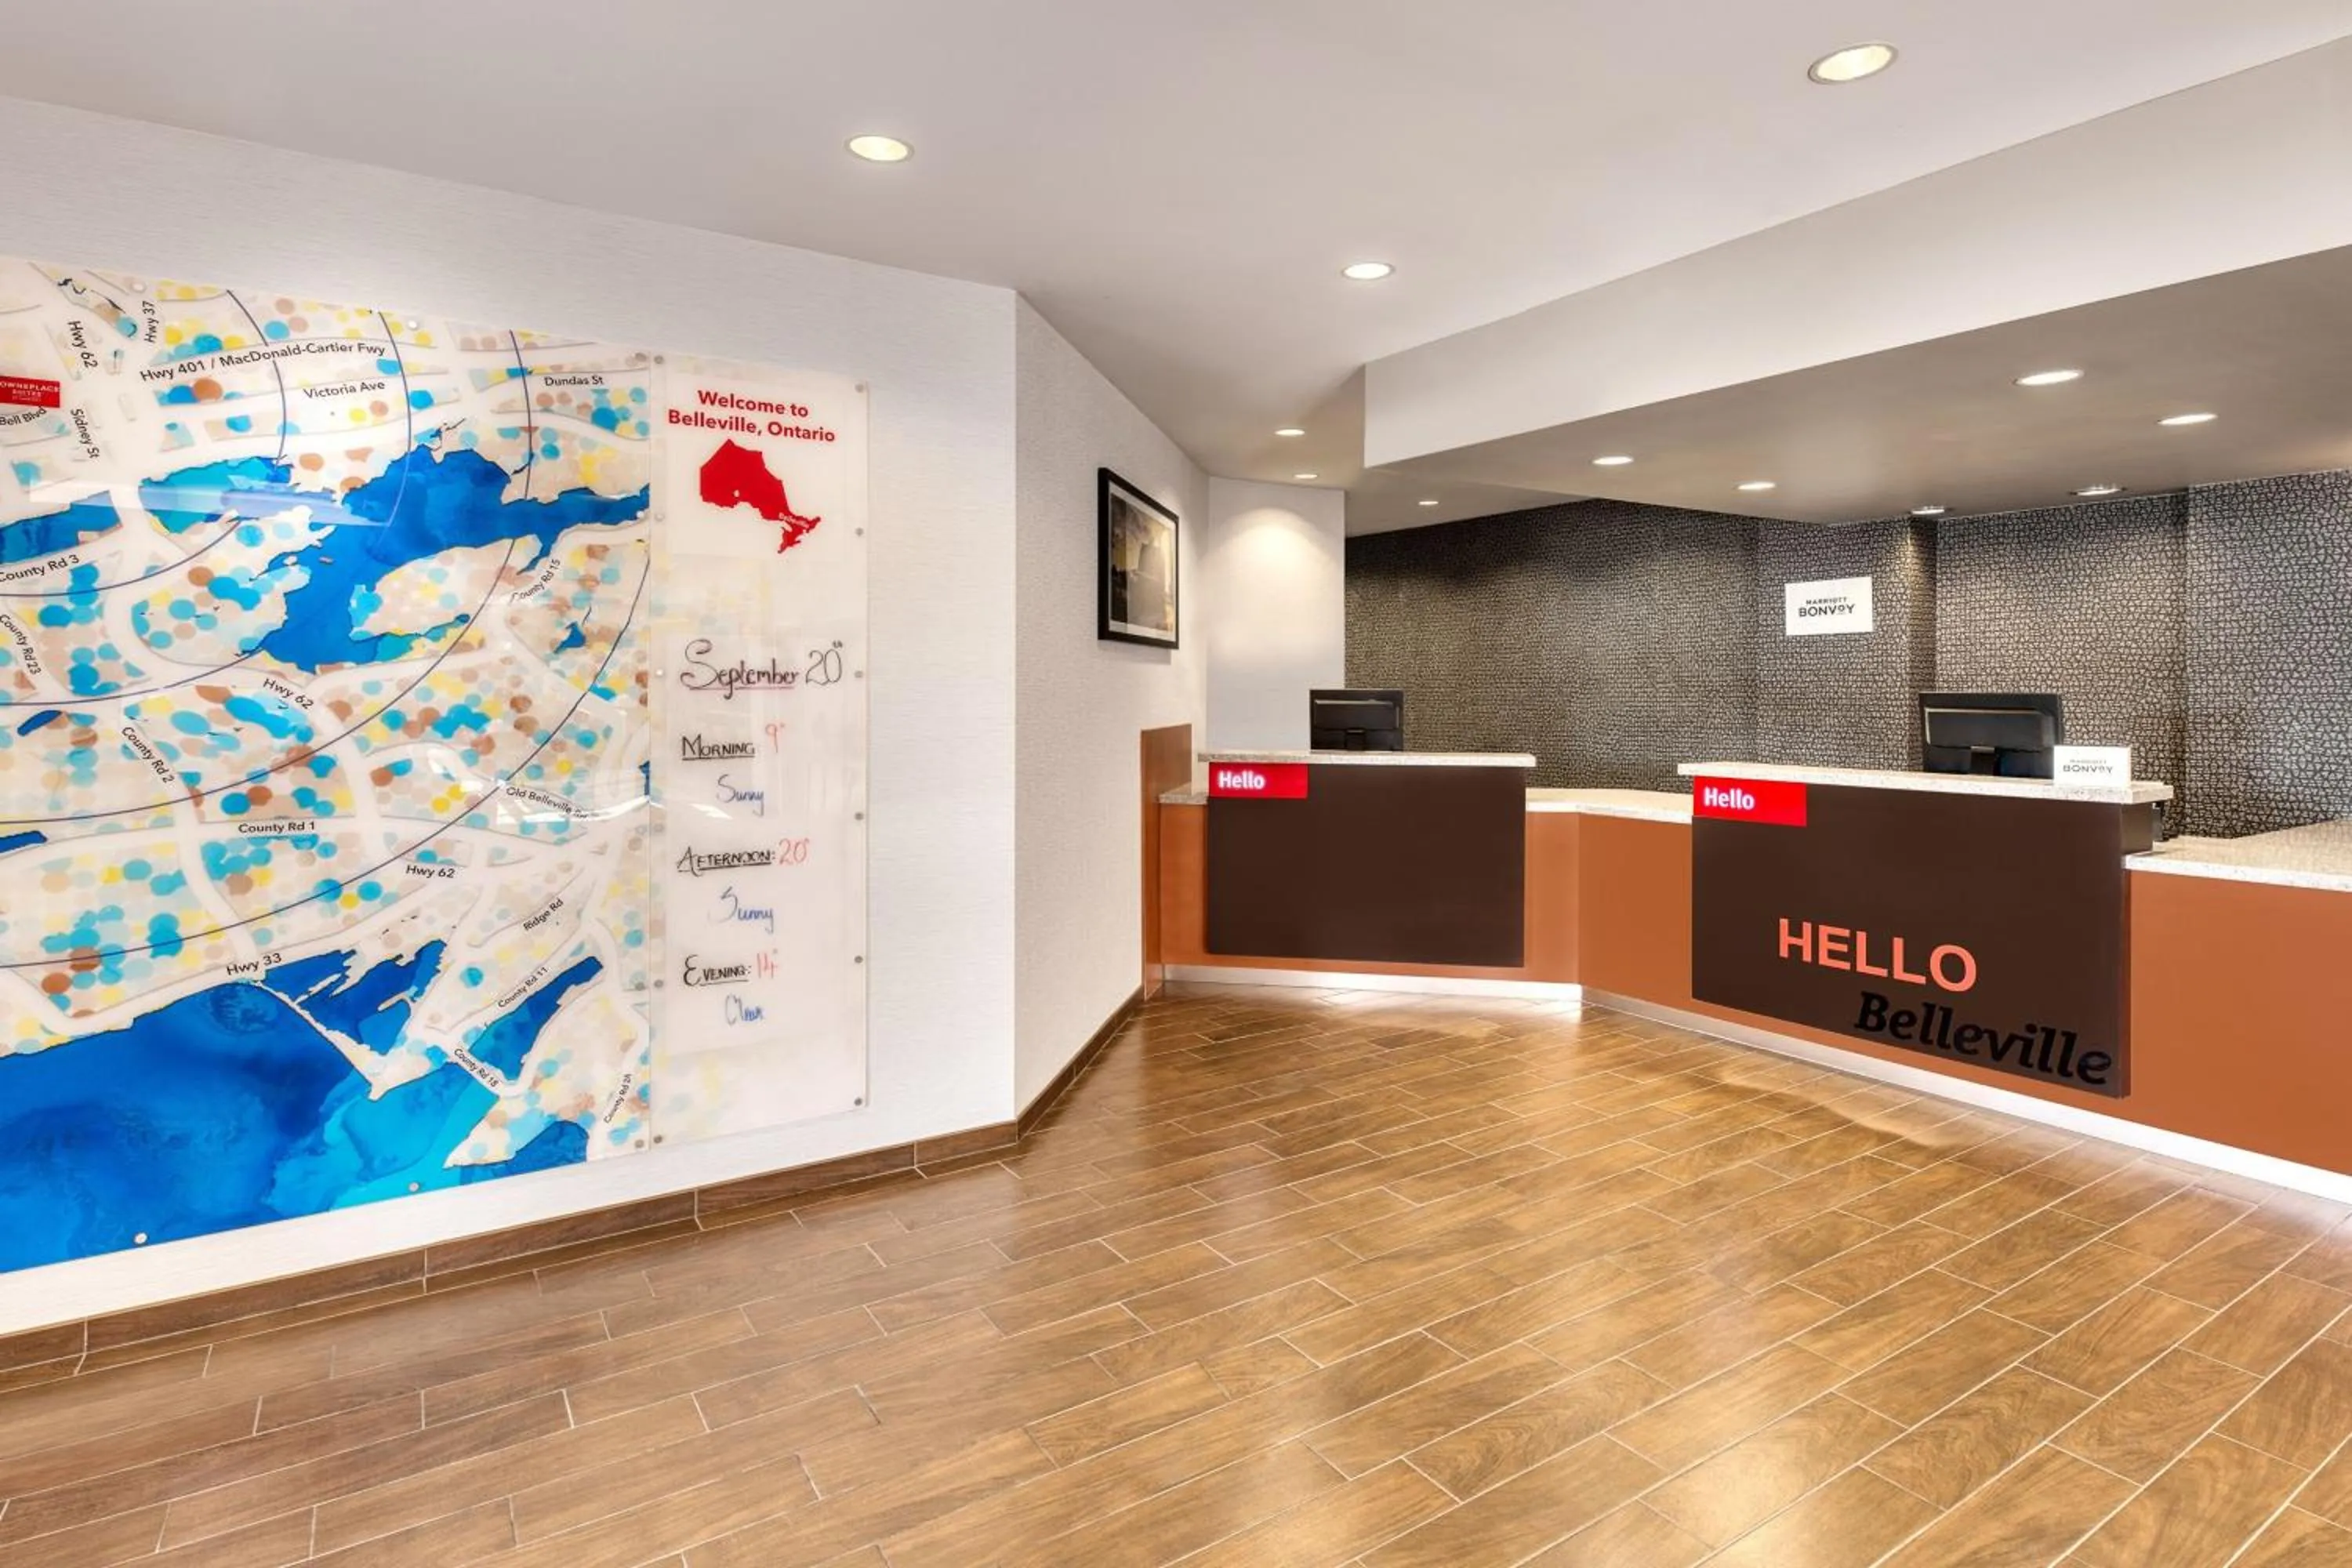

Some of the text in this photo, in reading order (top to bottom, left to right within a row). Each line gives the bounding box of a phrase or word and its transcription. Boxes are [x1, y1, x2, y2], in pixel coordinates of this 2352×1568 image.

[142, 301, 158, 343] Hwy 37
[67, 320, 98, 368] Hwy 62
[140, 368, 174, 382] Hwy
[177, 359, 206, 375] 401
[220, 342, 352, 367] MacDonald-Cartier
[358, 343, 385, 357] Fwy
[0, 381, 60, 392] OWNEPLACE
[303, 380, 386, 400] Victoria Ave
[544, 376, 603, 387] Dundas St
[698, 390, 808, 417] Welcome to
[70, 408, 99, 459] Sidney St
[668, 409, 835, 441] Belleville, Ontario
[47, 558, 67, 571] Rd
[68, 554, 79, 564] 3
[1798, 604, 1855, 617] BONVOY
[0, 614, 42, 675] County Rd 23
[680, 638, 800, 699] September
[263, 677, 314, 710] Hwy 62
[122, 727, 175, 783] County Rd 2
[506, 786, 527, 797] Old
[1219, 769, 1266, 789] Hello
[1703, 786, 1756, 811] Hello
[238, 822, 314, 834] County Rd 1
[405, 865, 456, 878] Hwy 62
[547, 898, 564, 913] Rd
[226, 953, 282, 976] Hwy 33
[1779, 917, 1976, 993] HELLO
[1853, 991, 2112, 1085] Belleville
